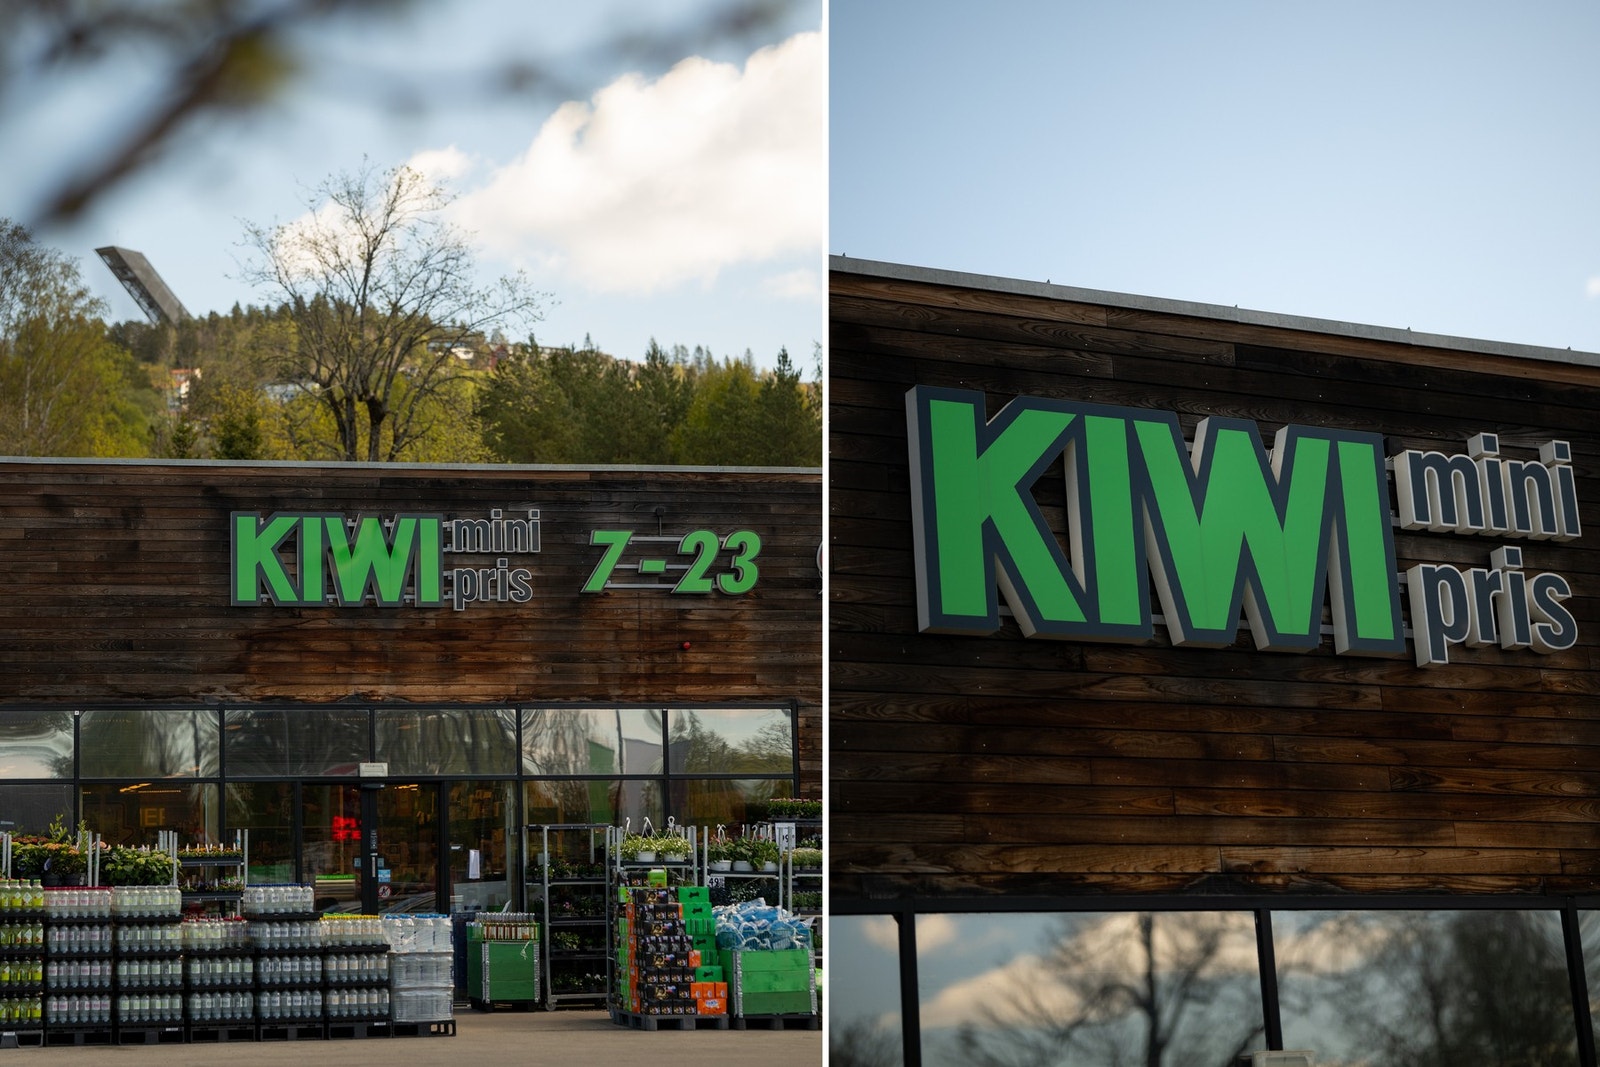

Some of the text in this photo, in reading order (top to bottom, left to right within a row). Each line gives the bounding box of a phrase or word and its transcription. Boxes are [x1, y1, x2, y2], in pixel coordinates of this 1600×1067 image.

[230, 509, 541, 607] KIWI mini
[914, 385, 1581, 653] KIWI mini
[453, 558, 533, 611] pris
[1408, 546, 1579, 668] pris
